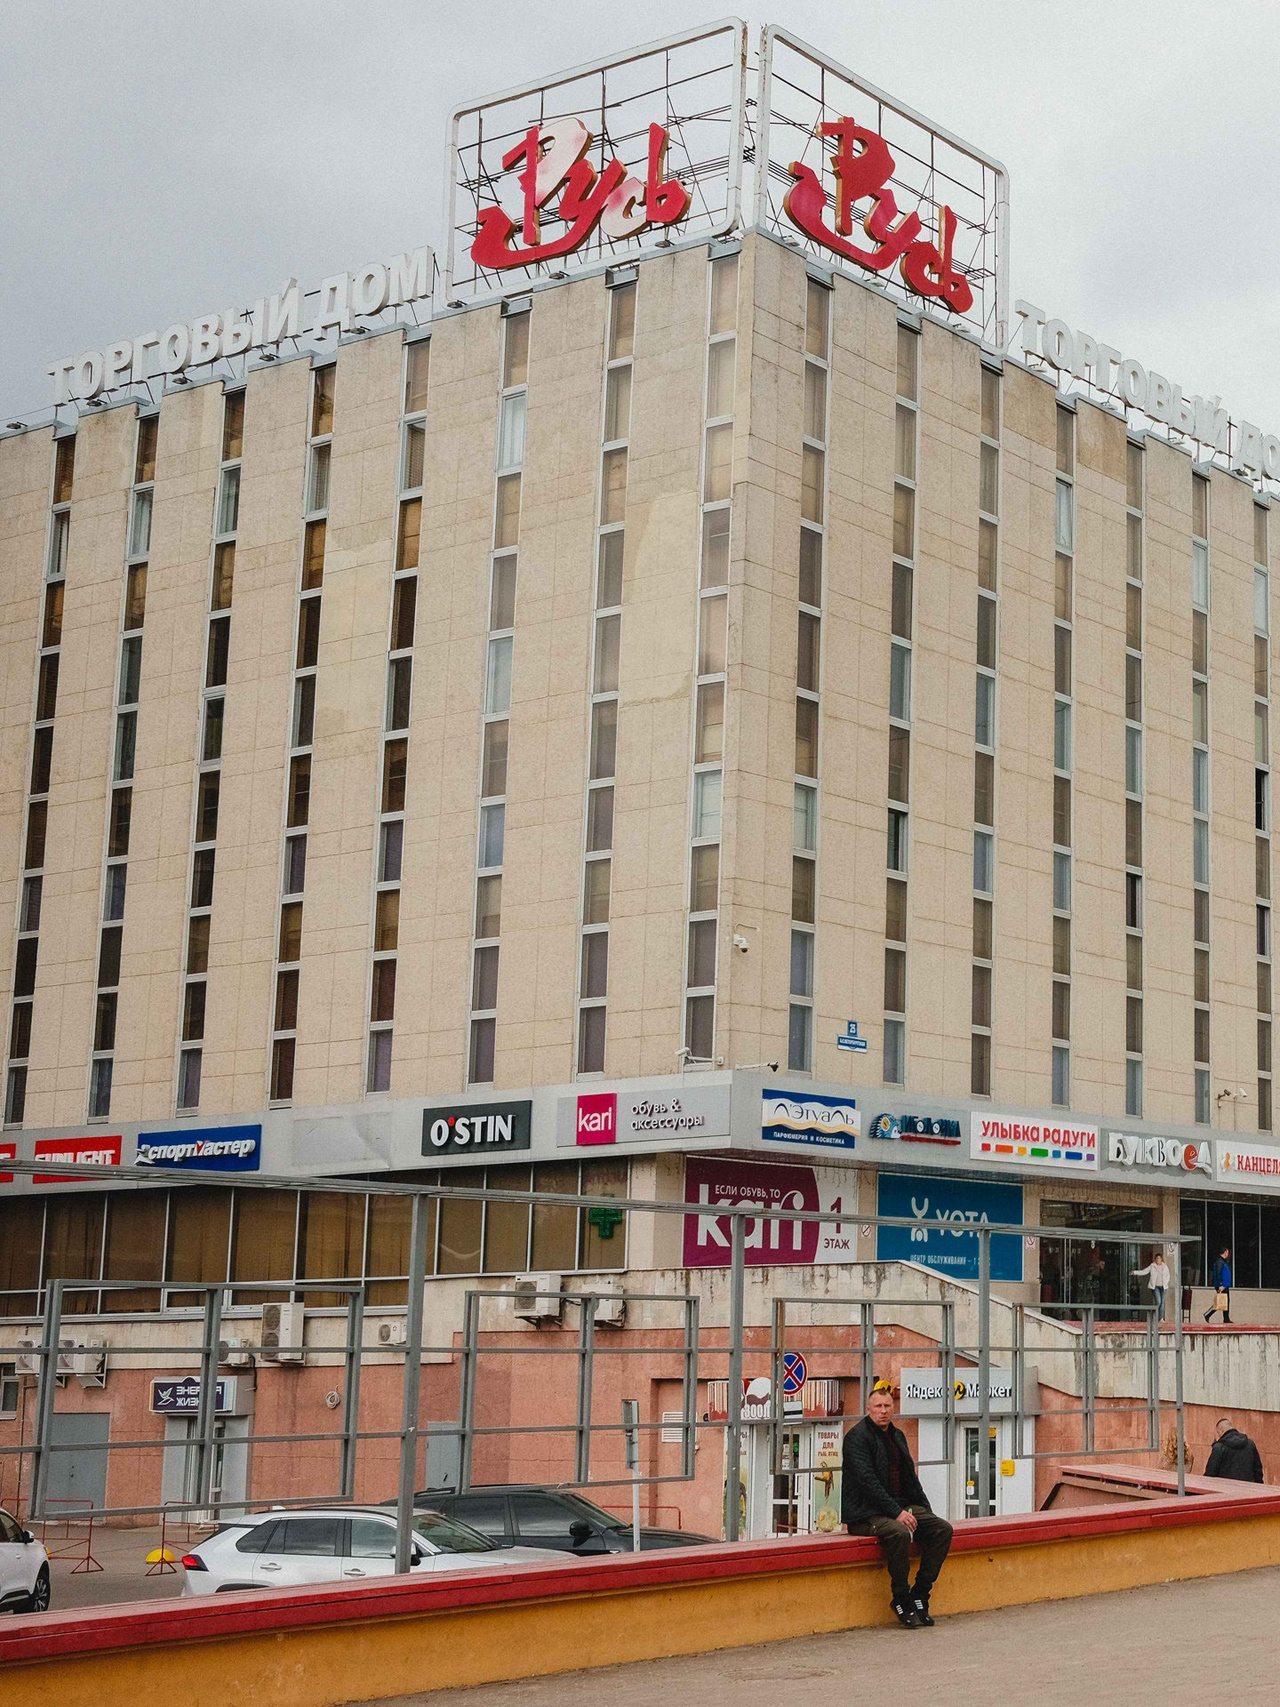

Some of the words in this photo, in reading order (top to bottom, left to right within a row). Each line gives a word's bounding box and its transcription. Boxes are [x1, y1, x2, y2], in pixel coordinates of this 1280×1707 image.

[471, 117, 691, 269] Русь
[784, 117, 974, 314] Русь
[47, 277, 303, 407] ТОРГОВЫЙ
[314, 245, 433, 341] ДОМ
[1015, 299, 1228, 455] ТОРГОВЫЙ
[631, 1100, 666, 1117] обувь
[670, 1098, 682, 1111] &
[578, 1107, 612, 1132] kari
[631, 1114, 704, 1131] аксессуары
[773, 1132, 808, 1141] ПАРФЮМЕРИЯ
[816, 1136, 845, 1145] КОСМЕТИКА
[715, 1185, 738, 1196] ЕСЛИ
[740, 1186, 769, 1199] ОБУВЬ,
[770, 1188, 781, 1199] ТО
[830, 1196, 842, 1234] 1
[823, 1238, 850, 1249] ЭТАЖ
[176, 1386, 222, 1395] ЭНЕРЯ
